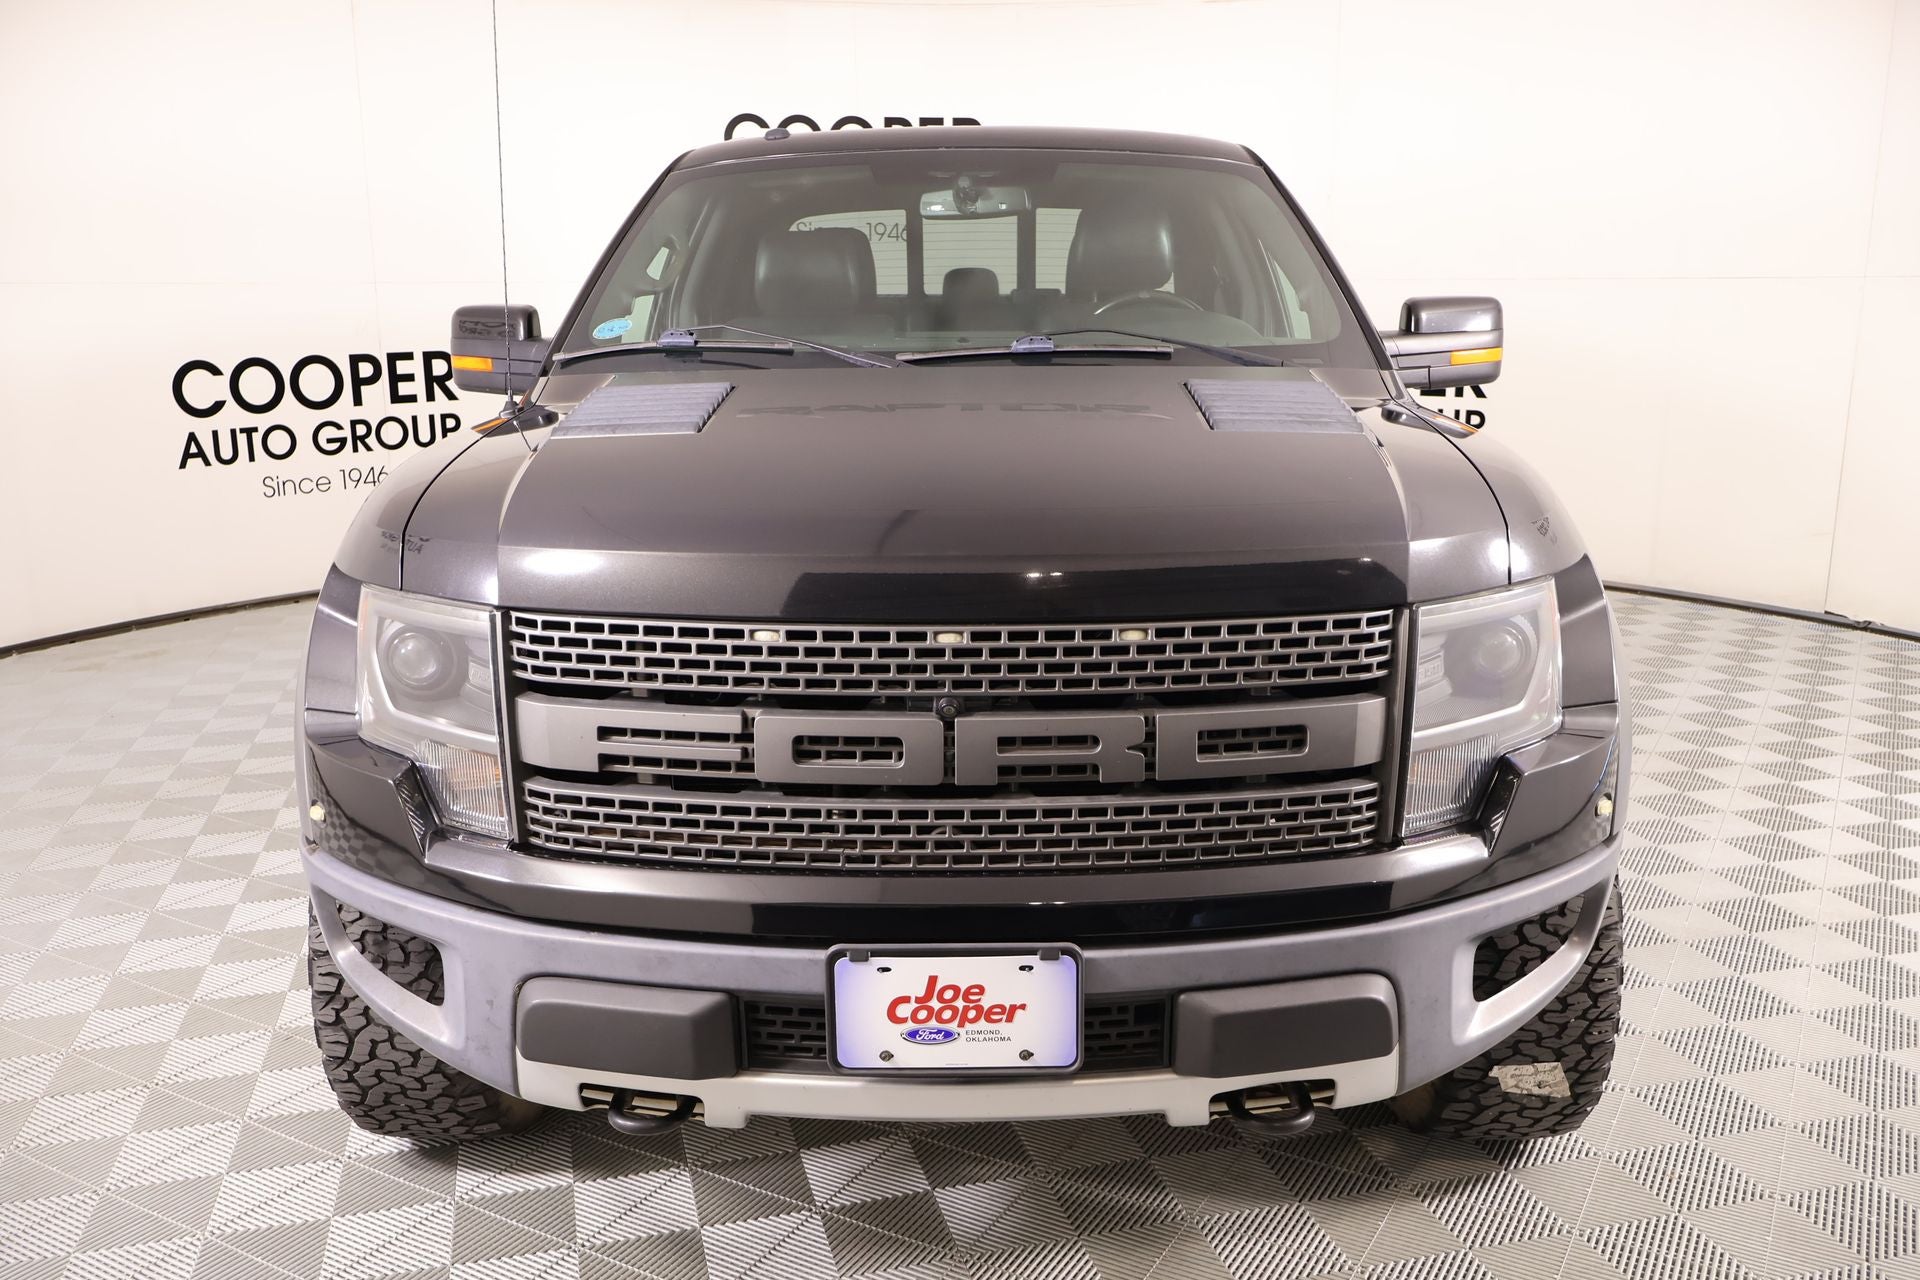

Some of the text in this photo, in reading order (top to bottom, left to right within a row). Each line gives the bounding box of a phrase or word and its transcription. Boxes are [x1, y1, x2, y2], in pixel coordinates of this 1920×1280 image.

[172, 351, 459, 418] COOPER
[178, 413, 462, 469] AUTO GROUP
[262, 474, 332, 498] Since
[515, 691, 1387, 786] FORD
[914, 975, 986, 1005] Joe
[886, 995, 1027, 1028] Cooper
[915, 1028, 945, 1041] Ford
